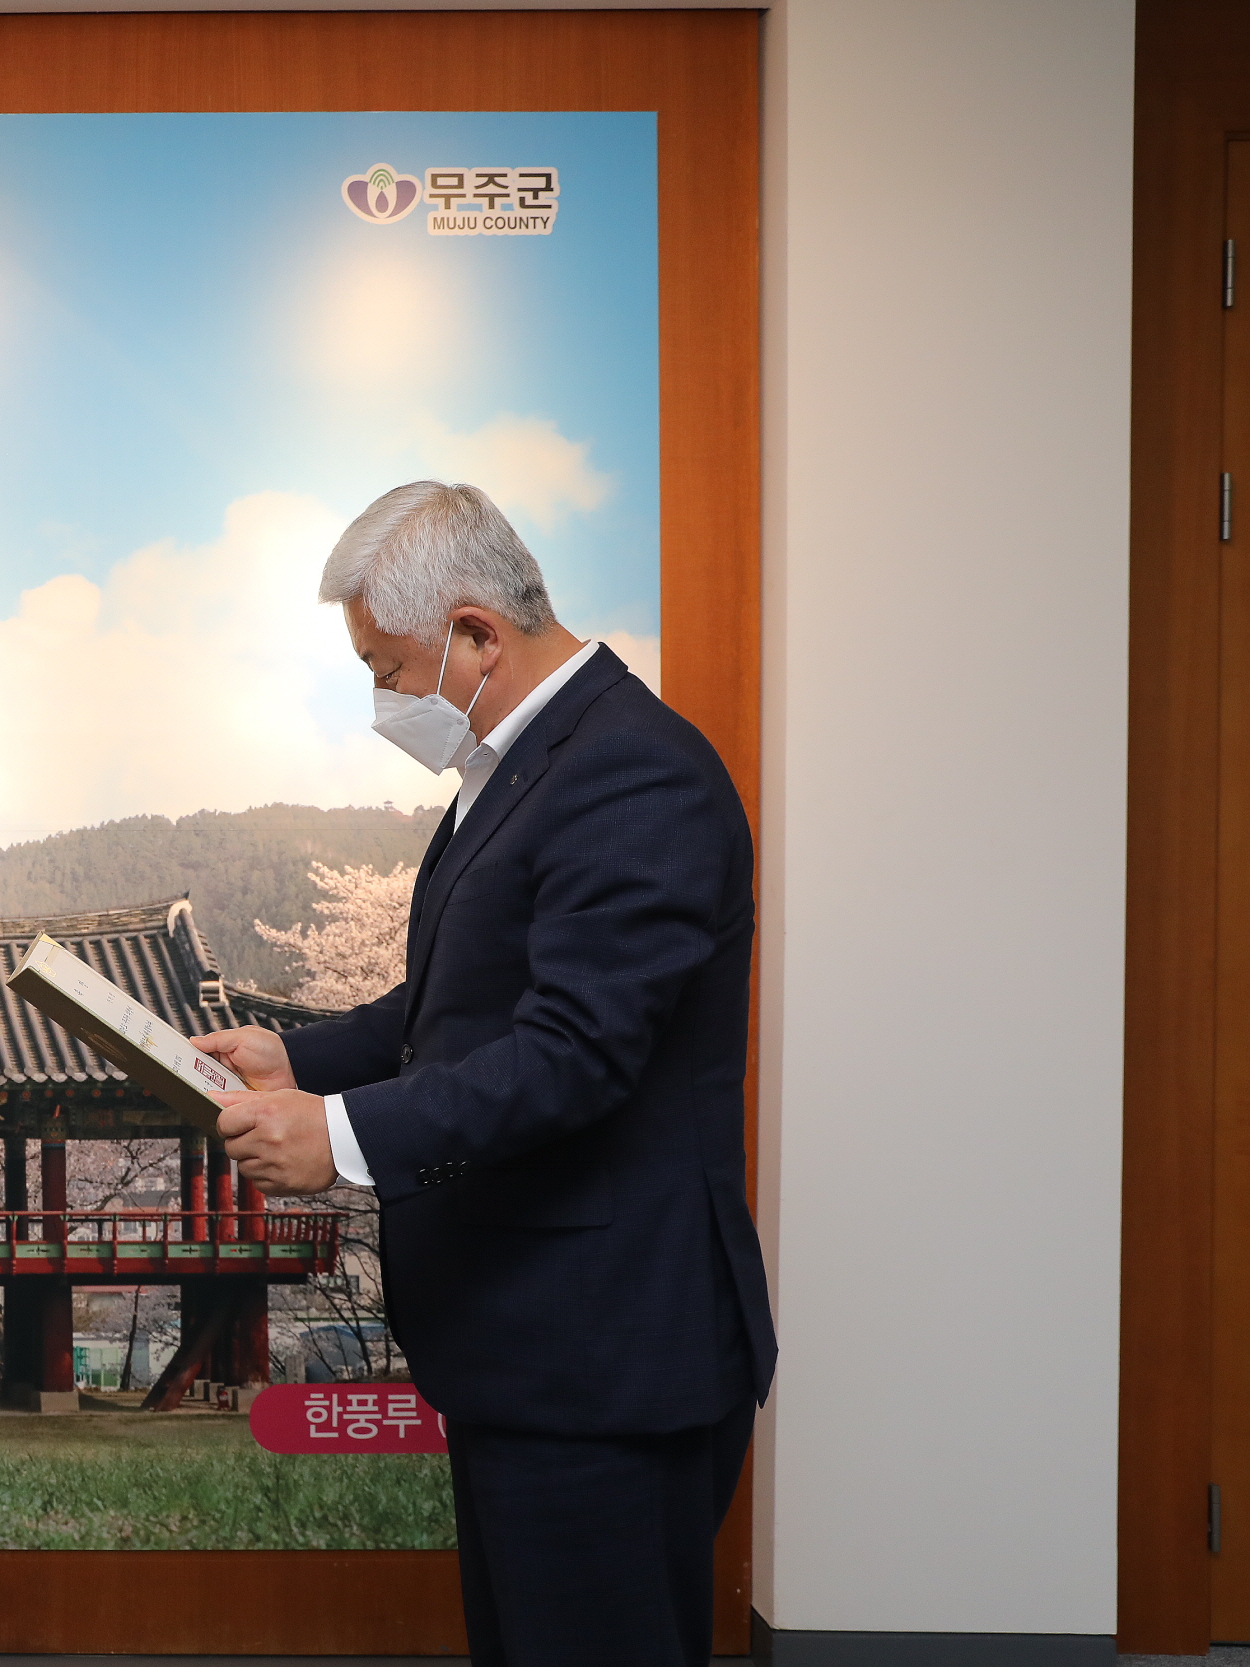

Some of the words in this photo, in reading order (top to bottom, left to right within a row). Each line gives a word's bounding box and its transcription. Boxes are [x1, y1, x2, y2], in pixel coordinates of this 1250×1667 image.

[429, 172, 554, 210] 무주군
[432, 216, 478, 230] MUJU
[482, 216, 550, 230] COUNTY
[304, 1393, 422, 1440] 한풍루
